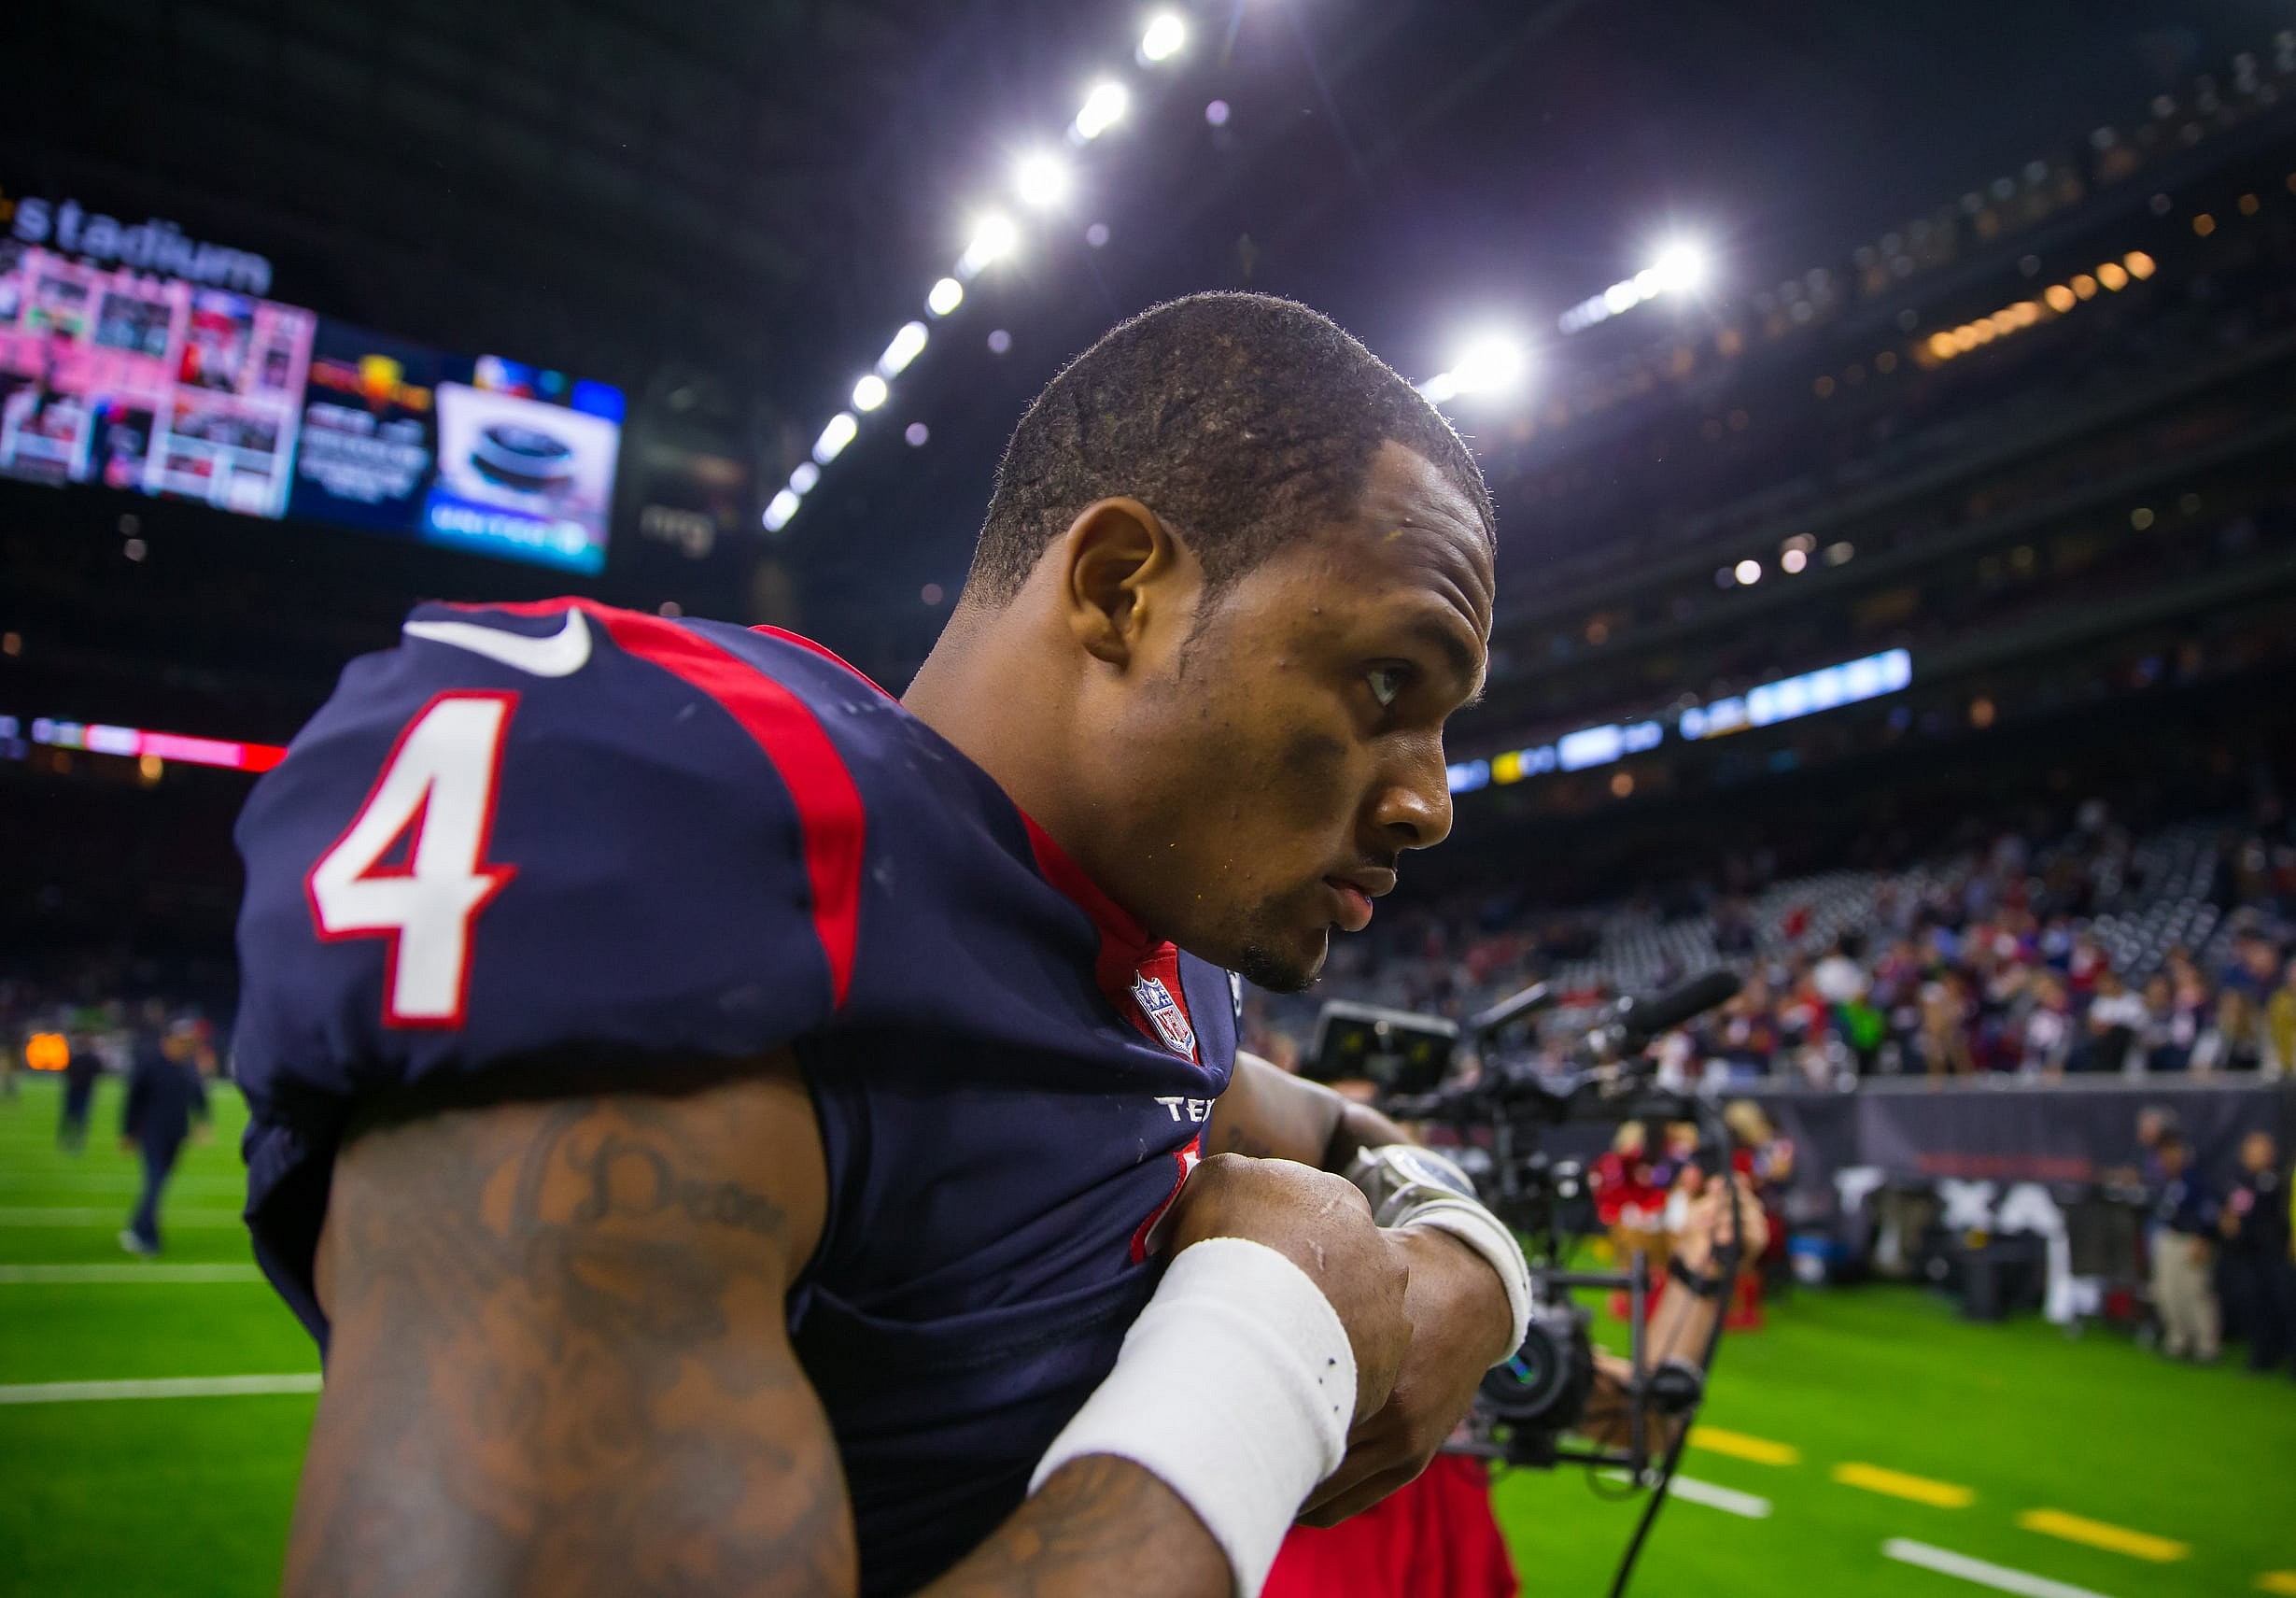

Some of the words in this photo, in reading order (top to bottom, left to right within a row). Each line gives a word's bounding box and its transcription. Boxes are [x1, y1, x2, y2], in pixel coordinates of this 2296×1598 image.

[13, 195, 273, 295] stadium
[304, 688, 520, 1030] 4
[1153, 1008, 1190, 1044] NFL
